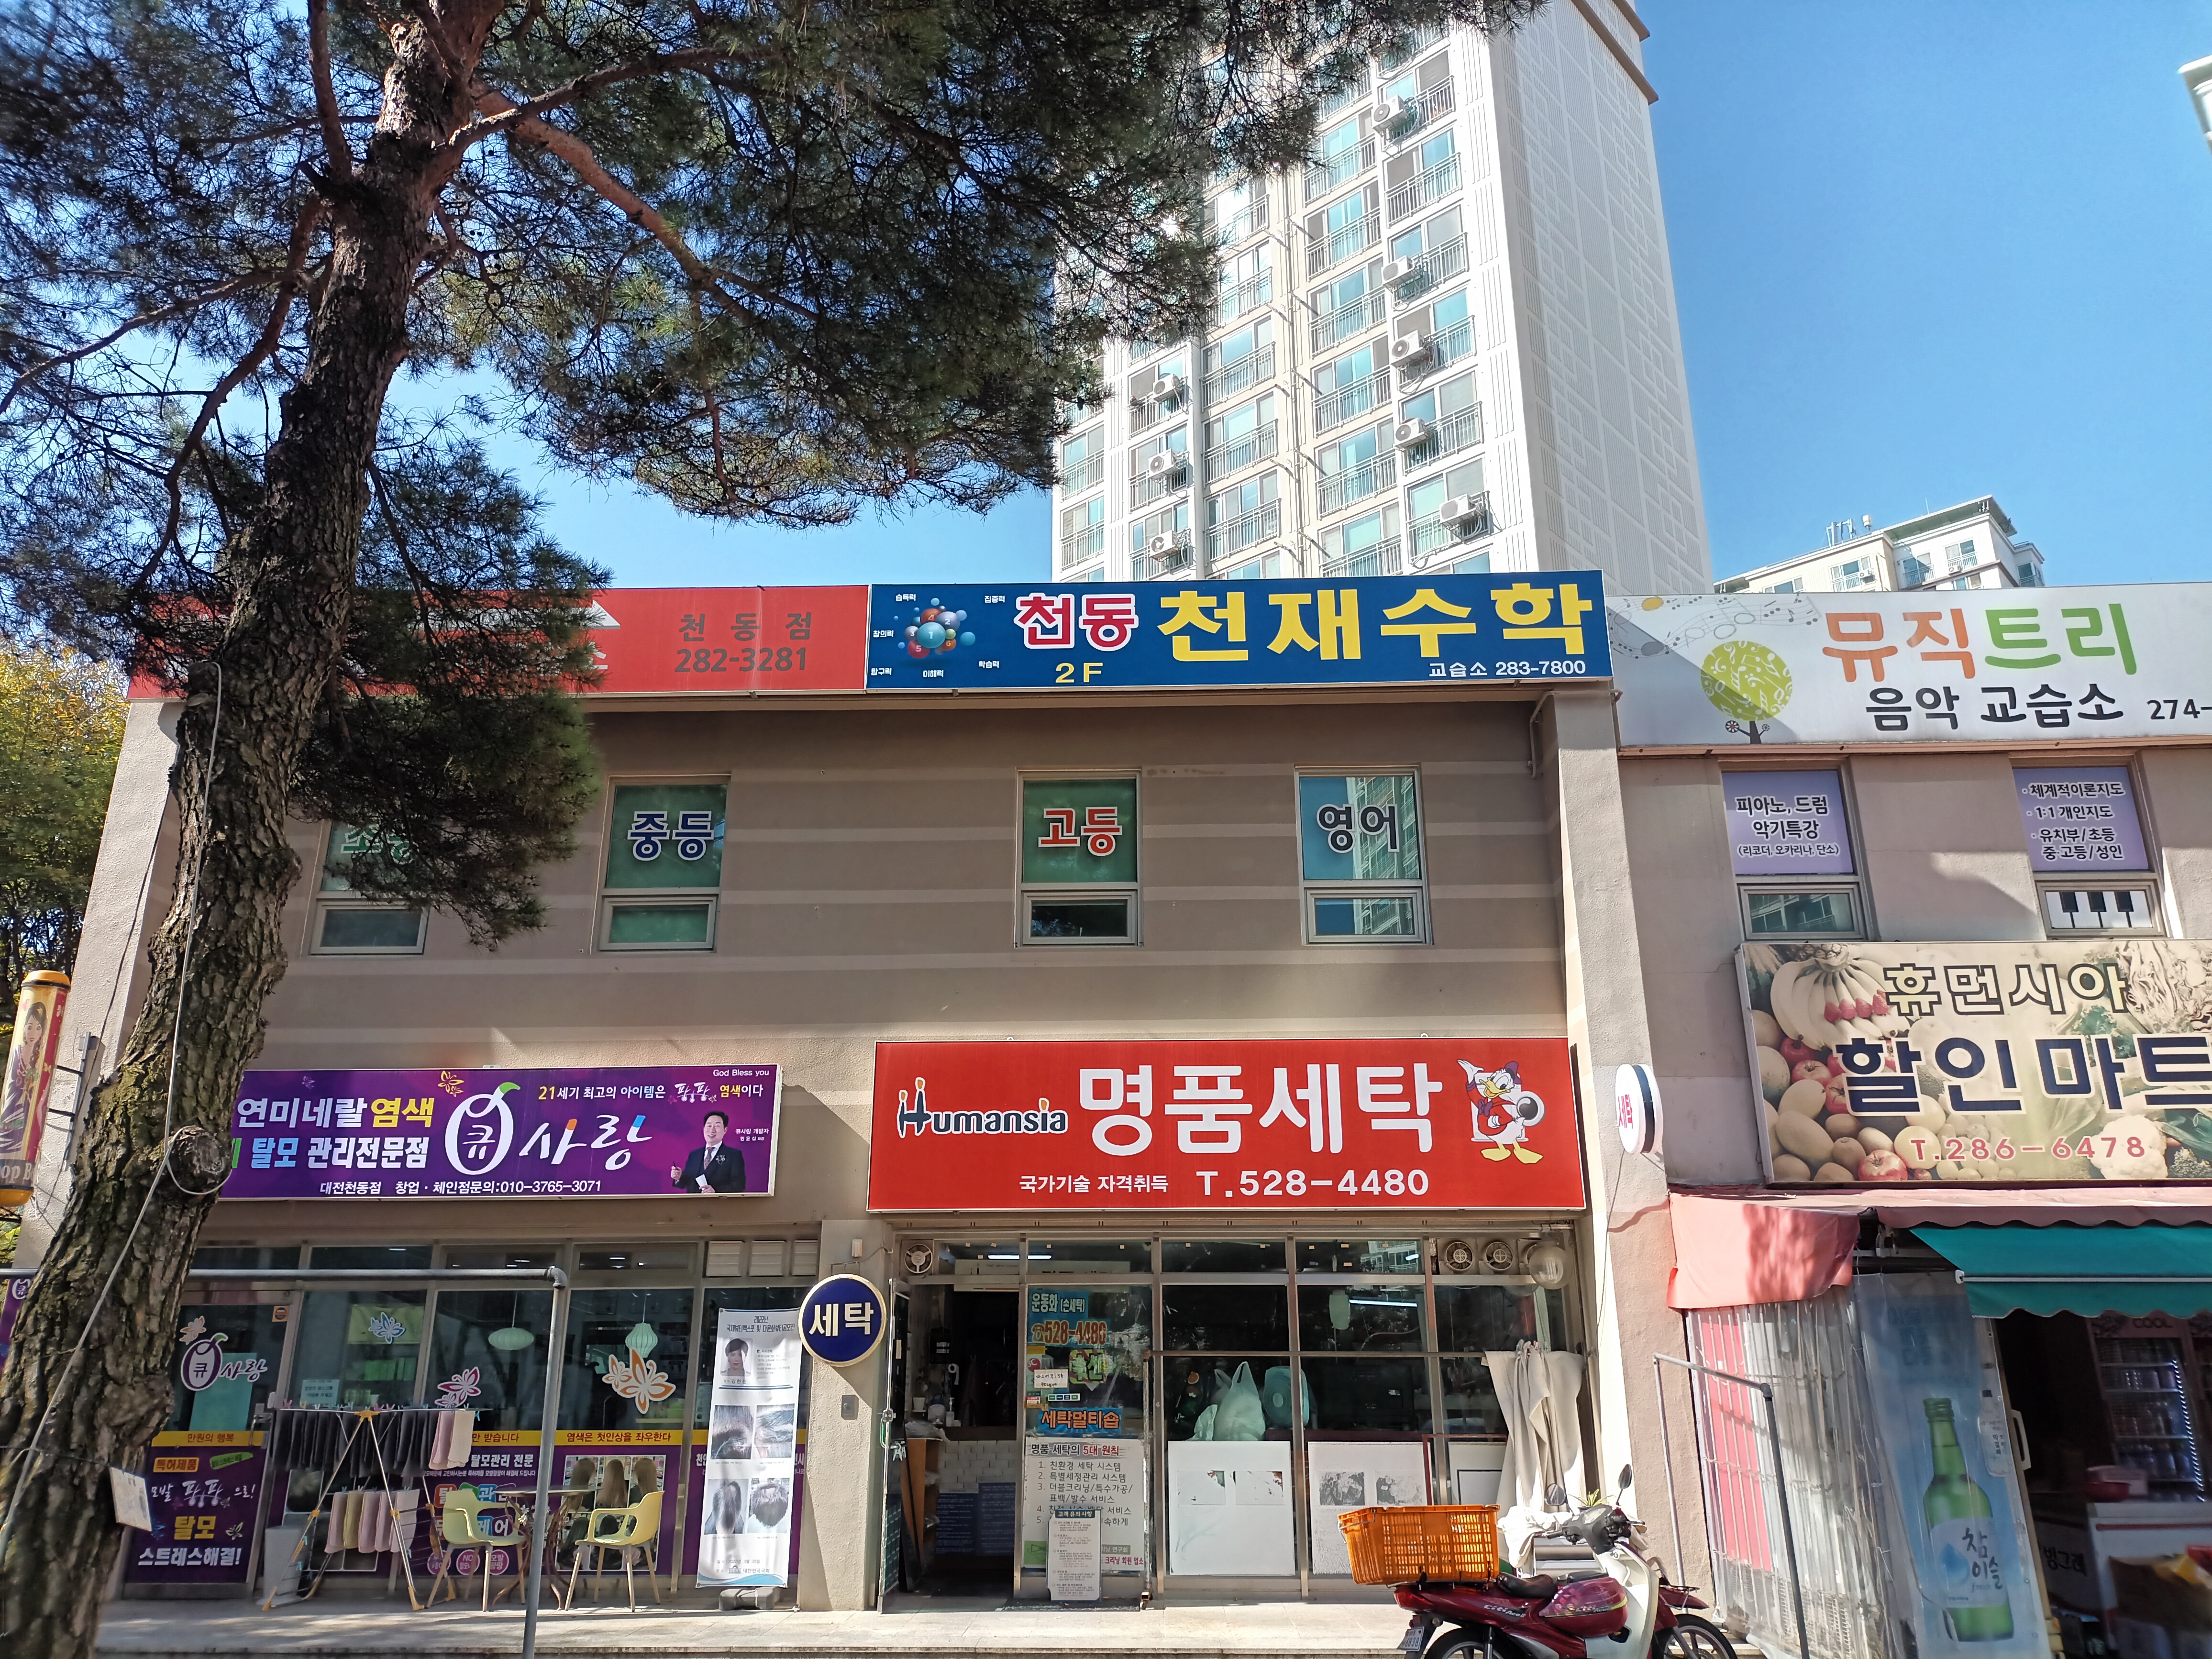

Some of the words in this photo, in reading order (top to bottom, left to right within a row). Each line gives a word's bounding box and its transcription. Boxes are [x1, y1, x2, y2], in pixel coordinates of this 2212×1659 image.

[984, 595, 1005, 603] 집중력
[1014, 593, 1139, 651] 천동
[1158, 583, 1593, 662] 천재수학
[1822, 604, 2137, 683] 뮤직트리
[675, 647, 806, 672] 282-3281
[1429, 662, 1487, 677] 교습소
[1495, 660, 1586, 675] 283-7800
[923, 670, 944, 678] 이해력
[1056, 663, 1103, 683] 2F
[1866, 687, 1959, 730] 음악
[1980, 684, 2124, 728] 교습소
[2030, 783, 2124, 797] 체계적이론지도
[1736, 797, 1791, 816] 피아노,
[1795, 796, 1827, 814] 드럼
[2036, 807, 2055, 818] 1:1
[2058, 806, 2113, 819] 개인지도
[628, 811, 714, 862] 중등
[1038, 807, 1123, 857] 고등
[1316, 803, 1400, 853] 영어
[1753, 820, 1819, 839] 악기특강
[1738, 846, 1772, 856] (리코더,
[1775, 845, 1814, 855] 오카리나,
[1817, 845, 1839, 855] 단소)
[1883, 962, 2129, 1018] 휴먼시아
[539, 1086, 579, 1100] 21세기
[583, 1086, 616, 1099] 최고의
[620, 1085, 665, 1099] 아이템은
[719, 1084, 763, 1097] 염색이다
[897, 1077, 1068, 1139] Humansia
[1079, 1063, 1442, 1156] 명품세탁
[519, 1115, 652, 1171] 사랑
[251, 1138, 299, 1168] 탈모
[308, 1137, 429, 1168] 관리전문점
[320, 1182, 381, 1194] 대전천동점
[395, 1181, 420, 1194] 창업
[1020, 1175, 1091, 1193] 국가기술
[1097, 1174, 1168, 1193] 자격취득
[1196, 1170, 1429, 1198] T.528-4480
[1032, 1293, 1058, 1313] 운동화
[809, 1303, 874, 1337] 세탁
[2133, 1317, 2173, 1328] COOL
[221, 1359, 267, 1382] 사랑
[1041, 1410, 1120, 1429] 세탁멀티숍
[188, 1434, 213, 1443] 만원의
[217, 1433, 234, 1442] 행복
[484, 1433, 519, 1442] 받습니다
[567, 1432, 593, 1442] 염색은
[597, 1432, 631, 1442] 첫인상을
[636, 1432, 671, 1442] 좌우한다
[1031, 1444, 1049, 1455] 명품
[1052, 1444, 1080, 1455] 세탁의
[1083, 1445, 1097, 1455] 5대
[1102, 1445, 1119, 1456] 원칙
[156, 1460, 197, 1471] 특허제품
[471, 1454, 510, 1467] 탈모관리
[514, 1454, 533, 1467] 전문
[1050, 1461, 1073, 1471] 친환경
[1078, 1462, 1093, 1471] 세탁
[1097, 1462, 1121, 1472] 시스템
[1050, 1472, 1098, 1482] 특별세정관리
[1102, 1474, 1126, 1483] 시스템
[152, 1483, 173, 1502] 모발
[234, 1484, 255, 1498] 으로!
[1091, 1495, 1115, 1504] 서비스
[1107, 1506, 1131, 1515] 서비스
[174, 1516, 216, 1540] 탈모
[138, 1548, 241, 1566] 스트레스해결!
[1105, 1557, 1120, 1565] 크리닝
[1122, 1557, 1131, 1565] 회원
[1134, 1557, 1143, 1565] 업소
